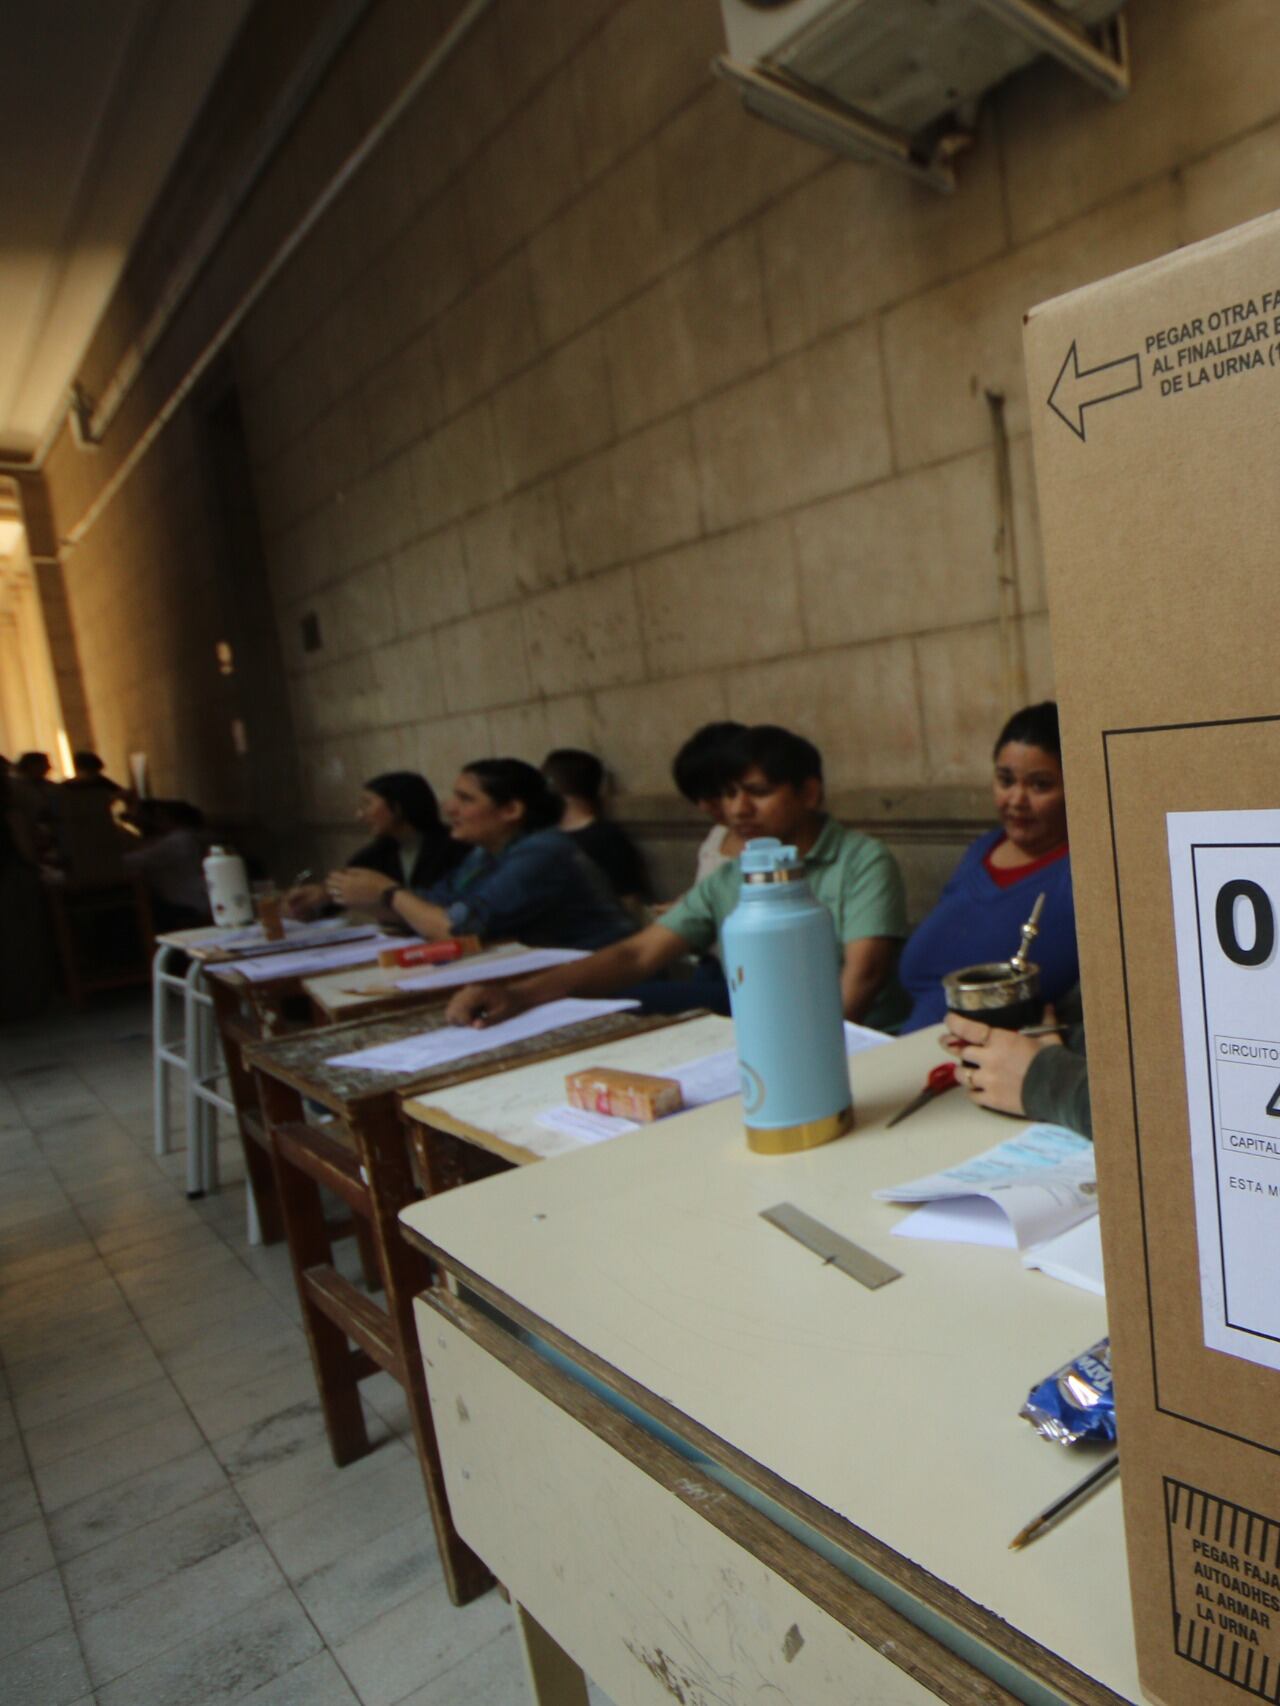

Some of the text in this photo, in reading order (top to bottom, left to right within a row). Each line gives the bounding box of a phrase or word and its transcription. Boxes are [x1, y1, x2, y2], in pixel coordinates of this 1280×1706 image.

[1145, 318, 1205, 354] PEGAR
[1208, 300, 1259, 332] OTRA
[1152, 357, 1175, 376] AL
[1177, 321, 1270, 368] FINALIZAR
[1160, 375, 1183, 397] DE
[1187, 367, 1211, 389] LA
[1213, 349, 1265, 380] URNA
[1229, 1134, 1280, 1156] CAPITAL
[1229, 1176, 1263, 1194] ESTA
[1192, 1538, 1241, 1573] PEGAR
[1195, 1582, 1271, 1631] AL ARMAR
[1196, 1602, 1260, 1647] LA URNA
